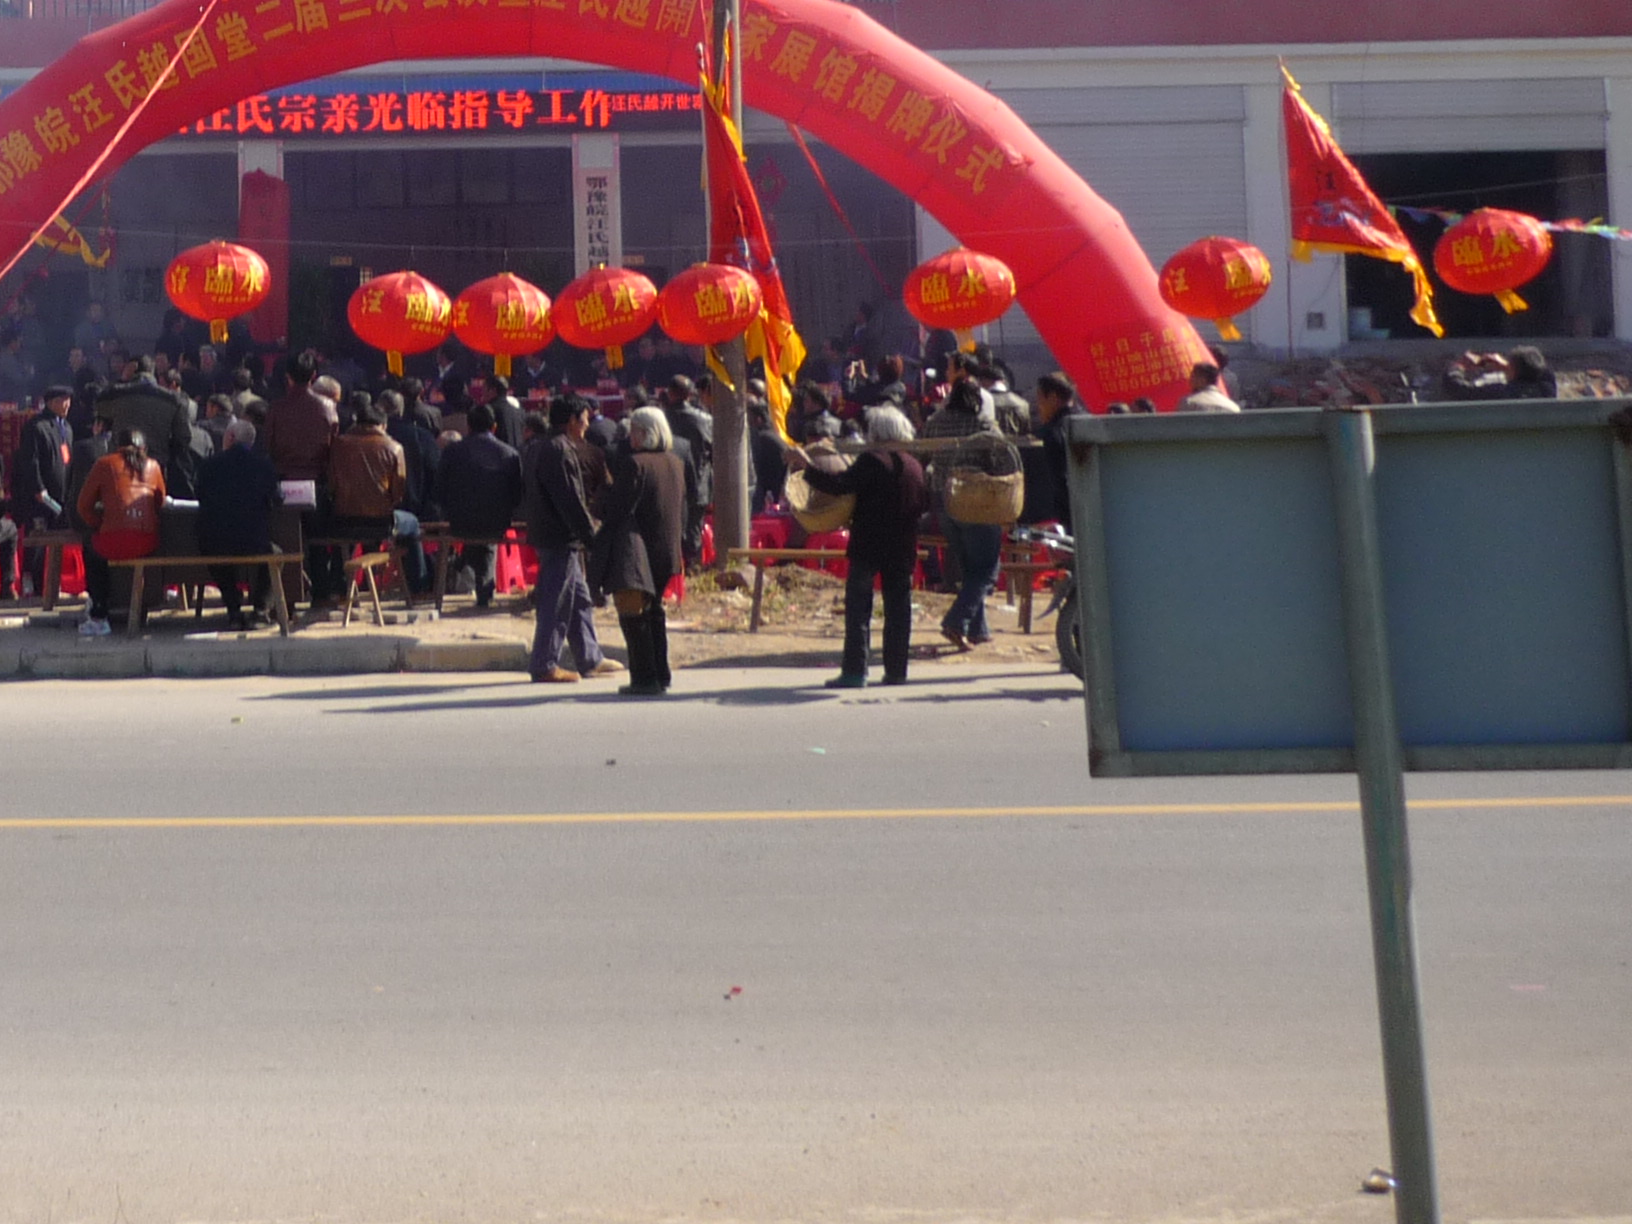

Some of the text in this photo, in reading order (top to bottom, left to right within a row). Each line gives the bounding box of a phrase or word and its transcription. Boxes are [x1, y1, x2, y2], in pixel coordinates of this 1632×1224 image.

[179, 90, 612, 134] 汪氏宗亲光临指导工作
